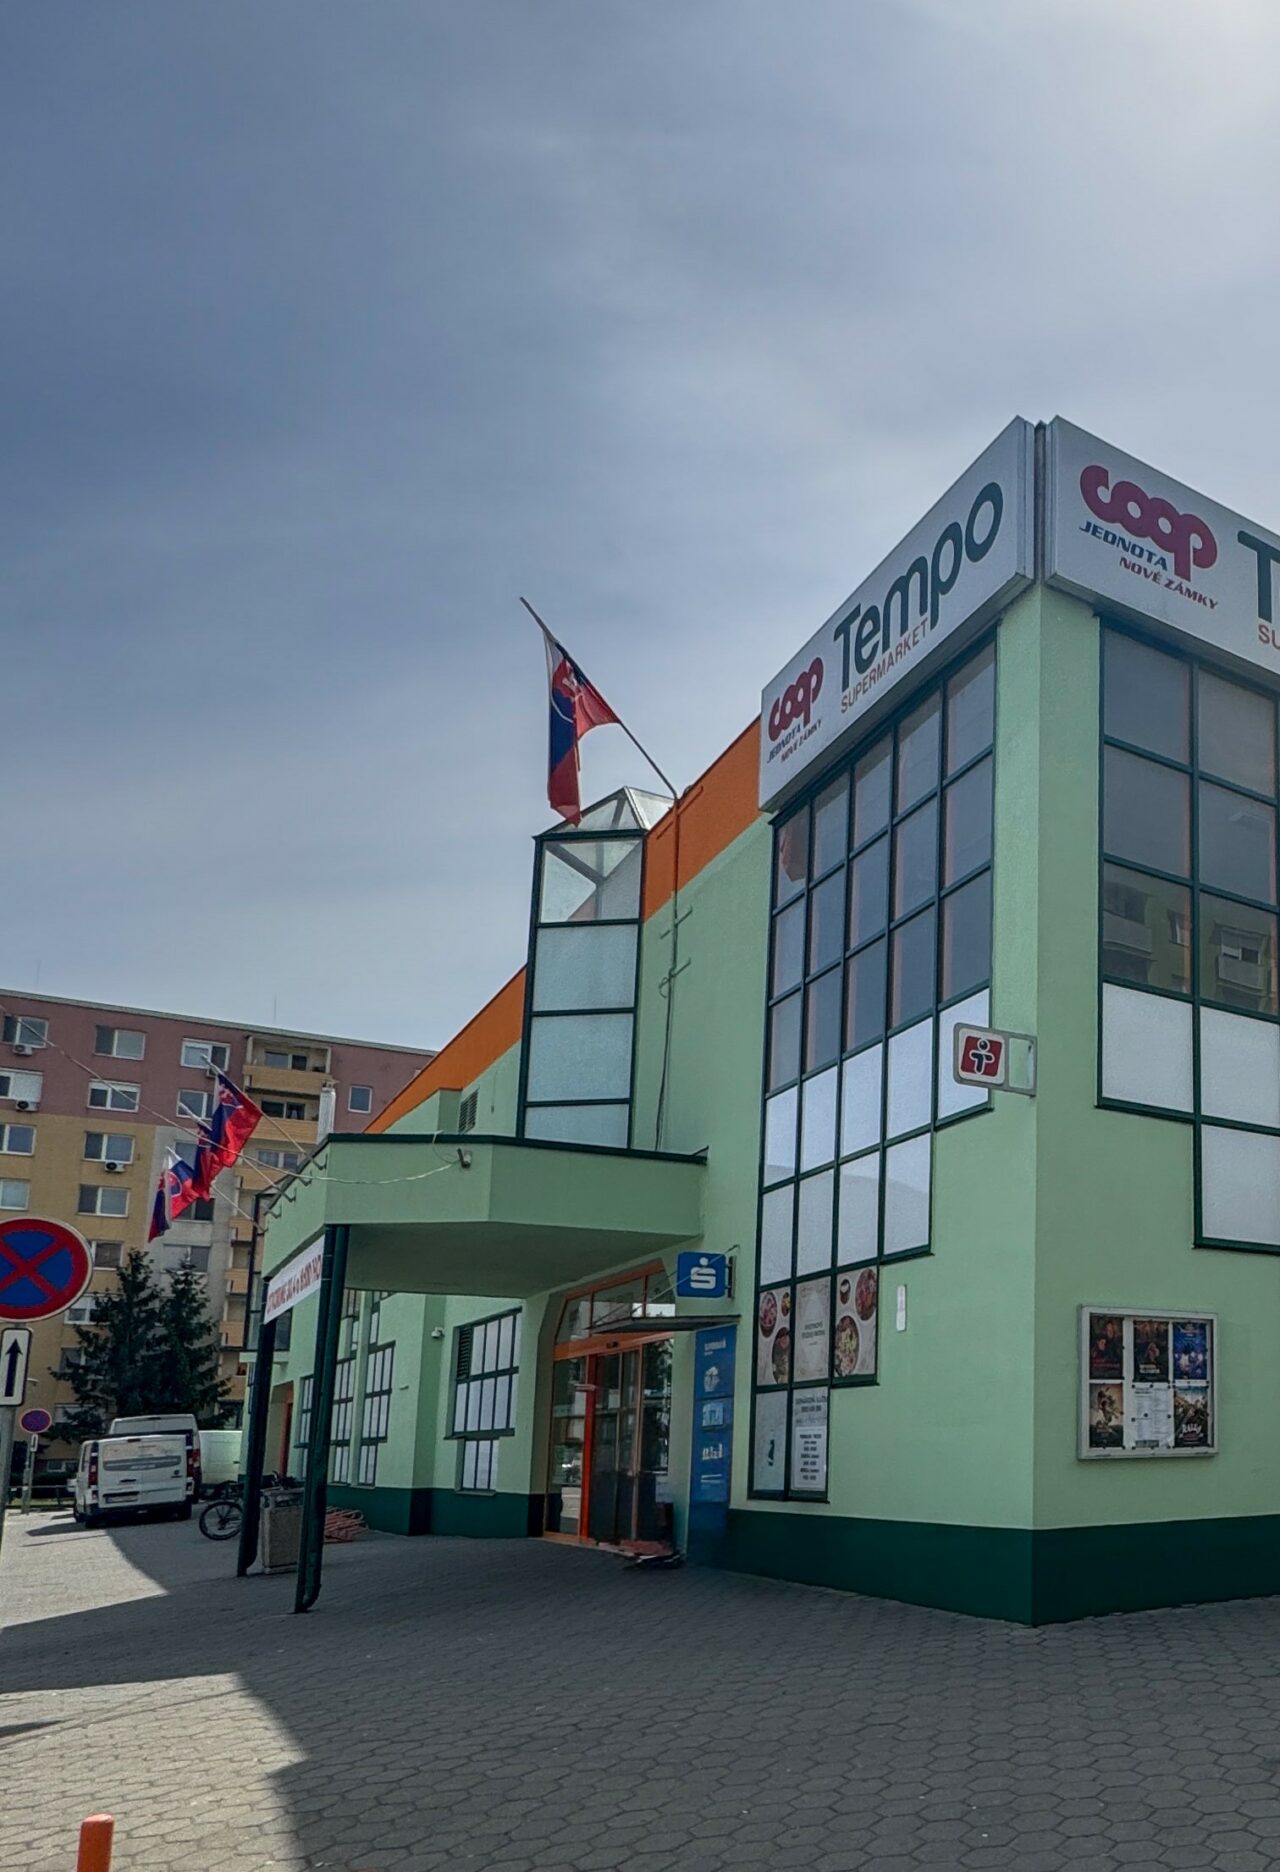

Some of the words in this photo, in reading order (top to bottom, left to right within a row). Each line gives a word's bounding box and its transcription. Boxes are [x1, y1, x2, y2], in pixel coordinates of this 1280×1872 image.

[1079, 520, 1169, 571] JEDNOTA
[1119, 555, 1164, 589] NOVÉ
[1164, 573, 1218, 610] ZÁMKY
[833, 482, 1004, 693] Tempo
[840, 617, 929, 714] SUPERMARKET
